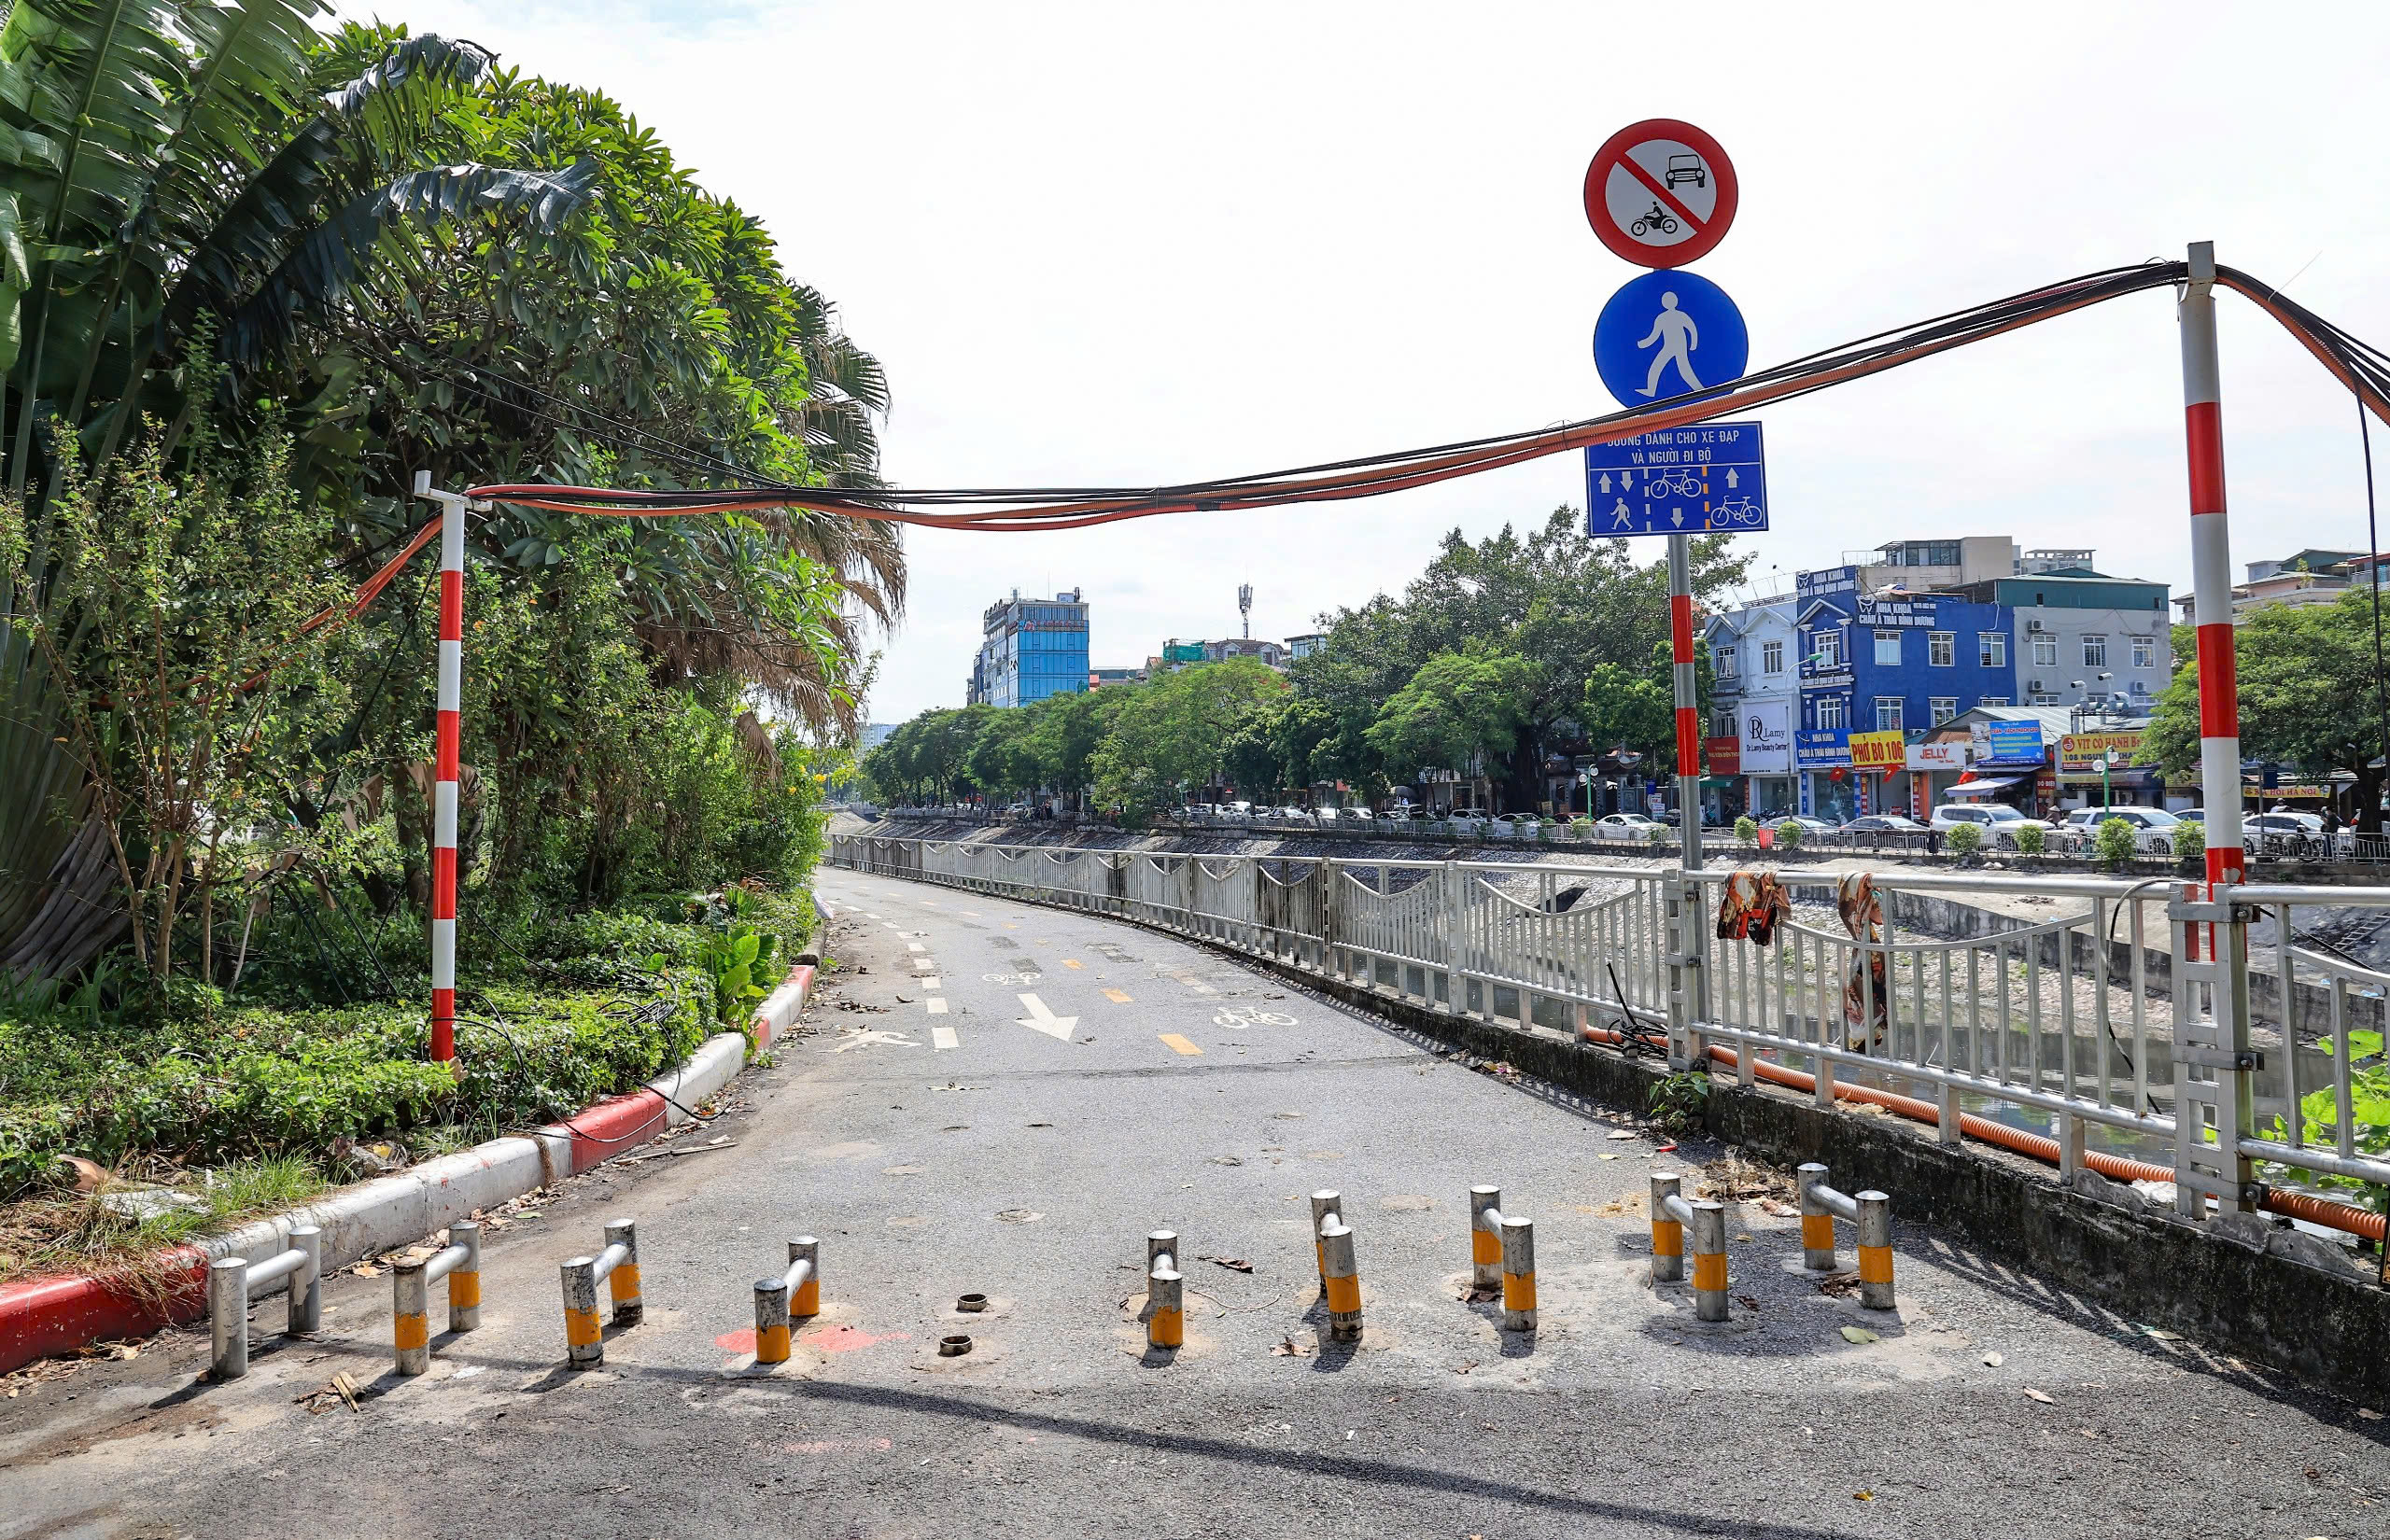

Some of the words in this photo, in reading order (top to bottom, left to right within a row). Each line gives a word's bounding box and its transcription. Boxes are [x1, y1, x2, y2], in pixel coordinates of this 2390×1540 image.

[1645, 431, 1673, 445] DÀNH
[1677, 431, 1697, 444] CHO
[1701, 430, 1715, 443] XE
[1719, 429, 1739, 444] ĐẠP
[1631, 449, 1645, 464] VÀ
[1649, 448, 1680, 463] NGƯỜI
[1683, 450, 1694, 462] ĐI
[1698, 447, 1711, 464] BỘ
[1813, 571, 1827, 584] NHA
[1827, 568, 1846, 581] KHOA
[1877, 602, 1891, 613] NHA
[1892, 603, 1912, 614] KHOA
[1850, 735, 1871, 763] PHỞ
[1871, 736, 1885, 762] BÒ
[1886, 740, 1904, 761] 106
[1919, 748, 1948, 760] JELLY
